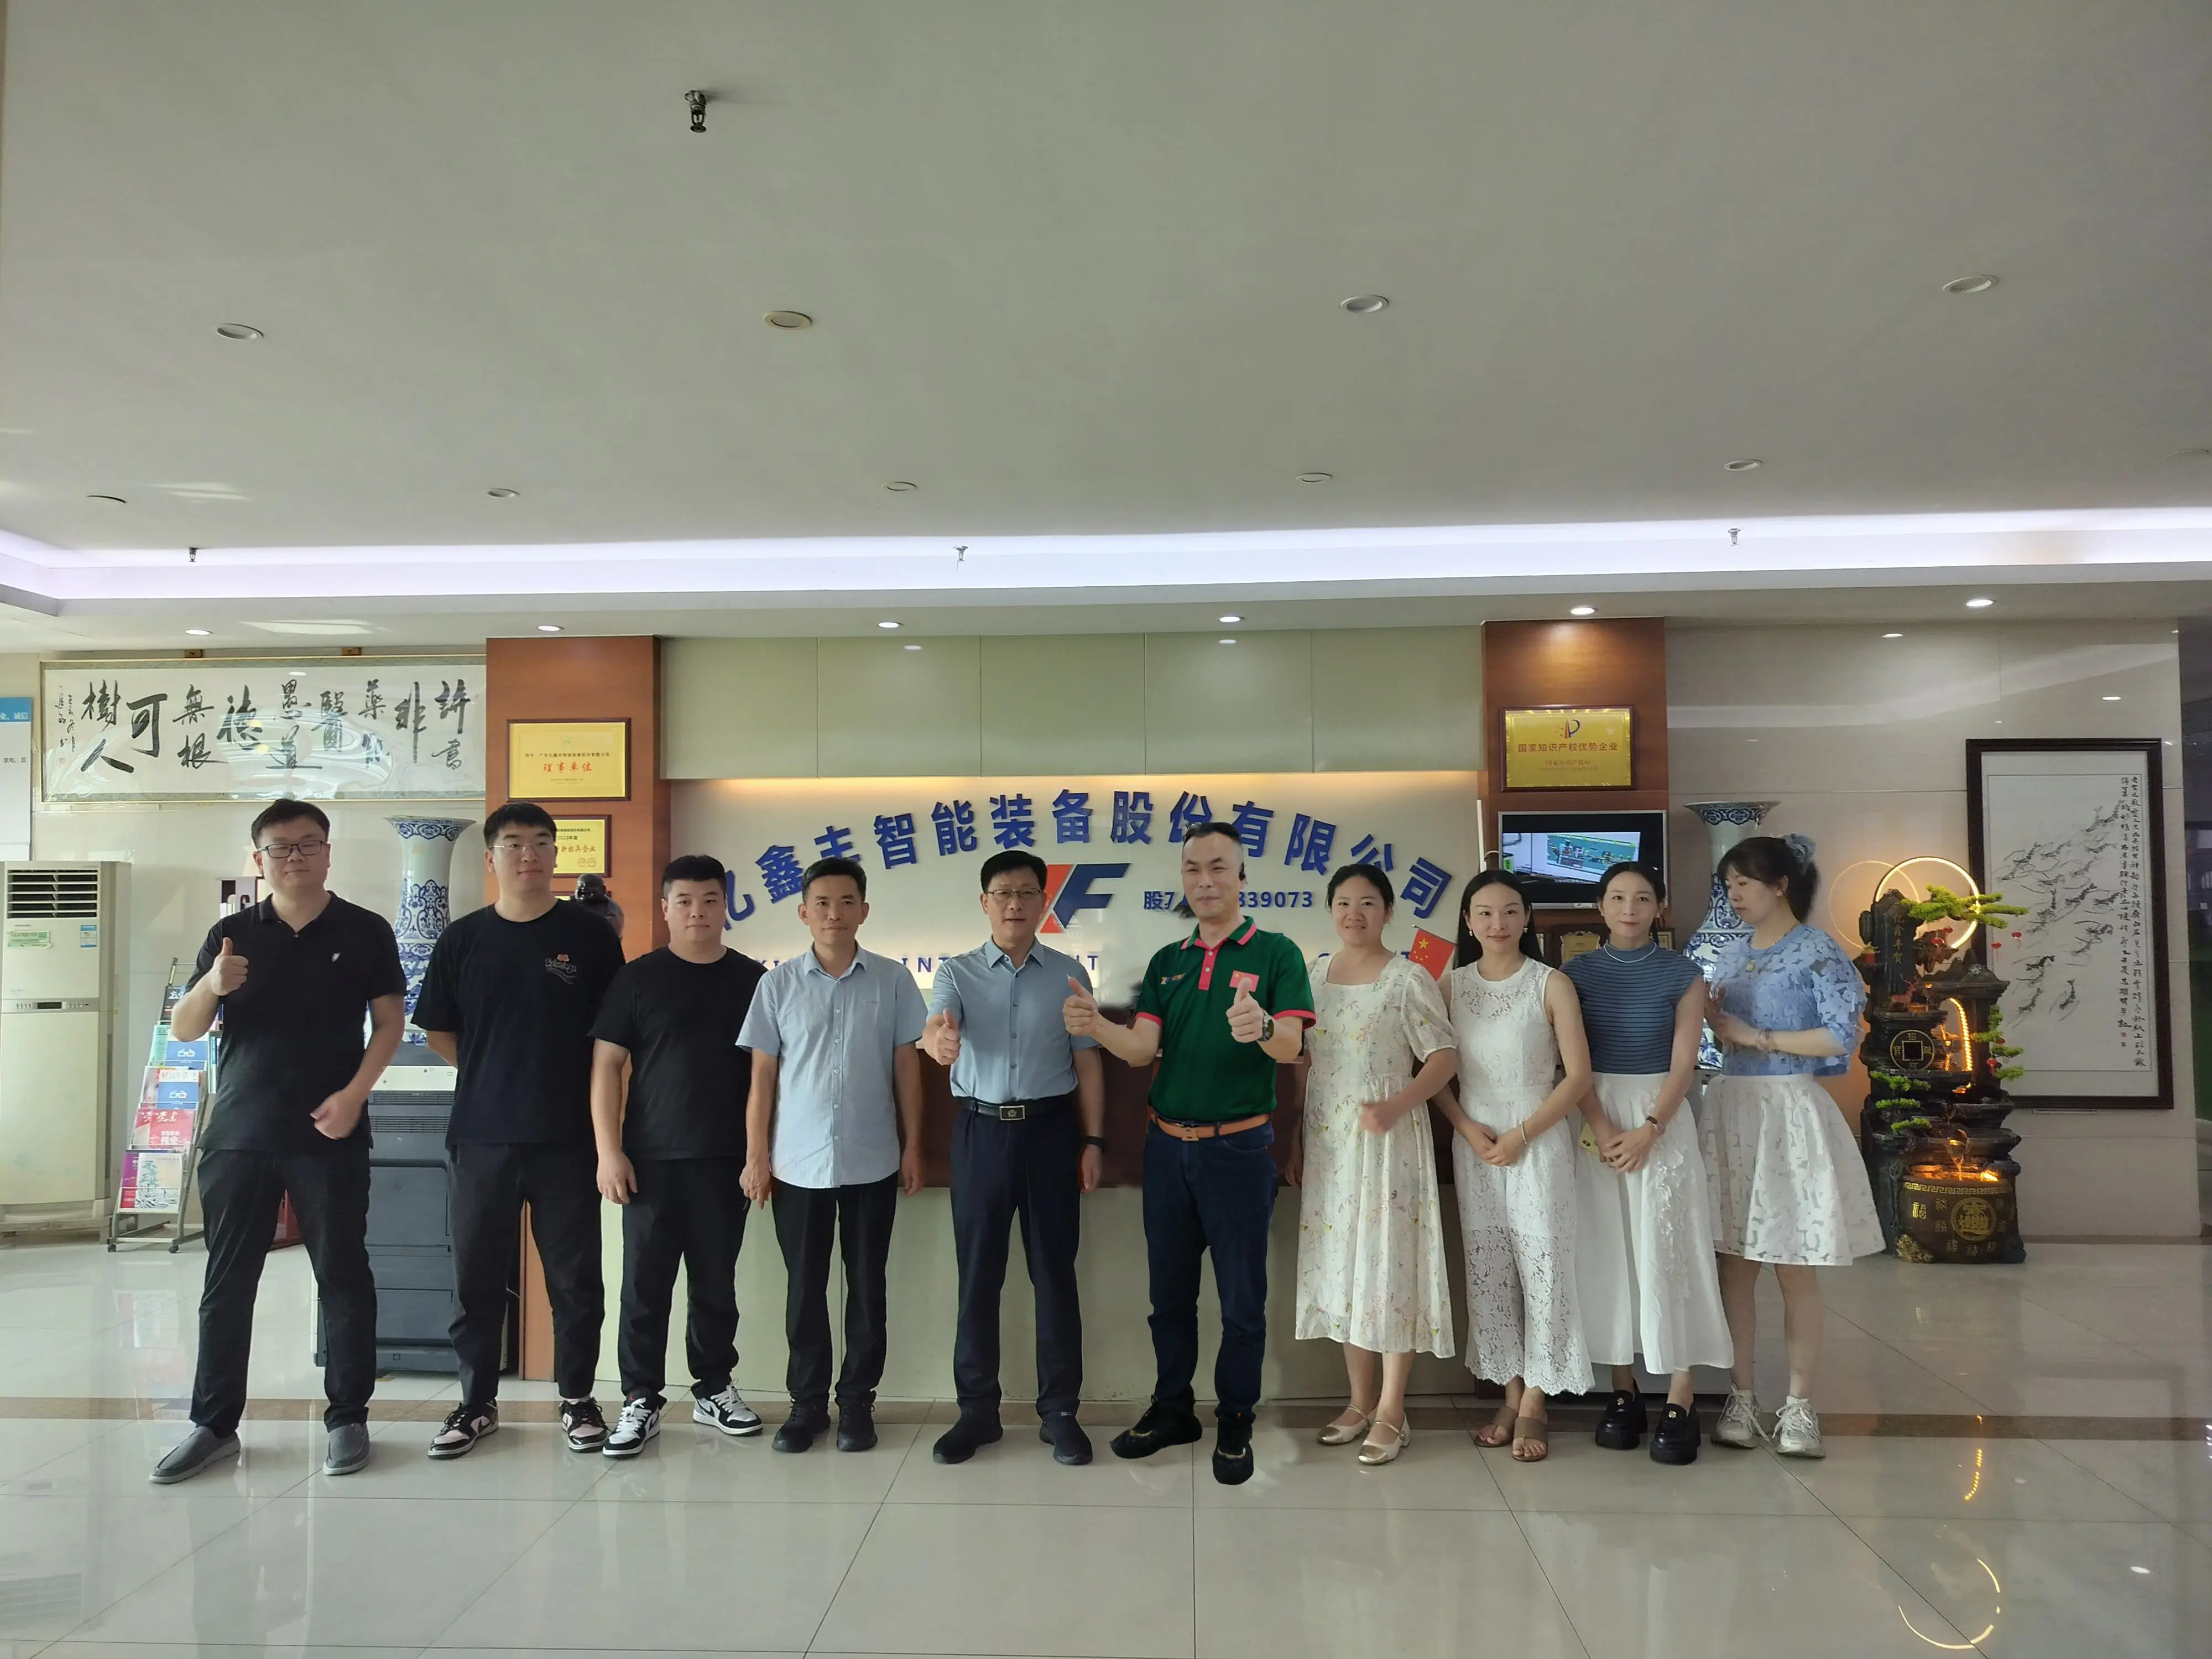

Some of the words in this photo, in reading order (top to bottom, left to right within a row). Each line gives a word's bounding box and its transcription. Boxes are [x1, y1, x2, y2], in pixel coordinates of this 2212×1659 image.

[1518, 742, 1618, 752] 国家知识产权优势企业
[544, 761, 593, 773] 理事单位
[1912, 1202, 1928, 1220] 福
